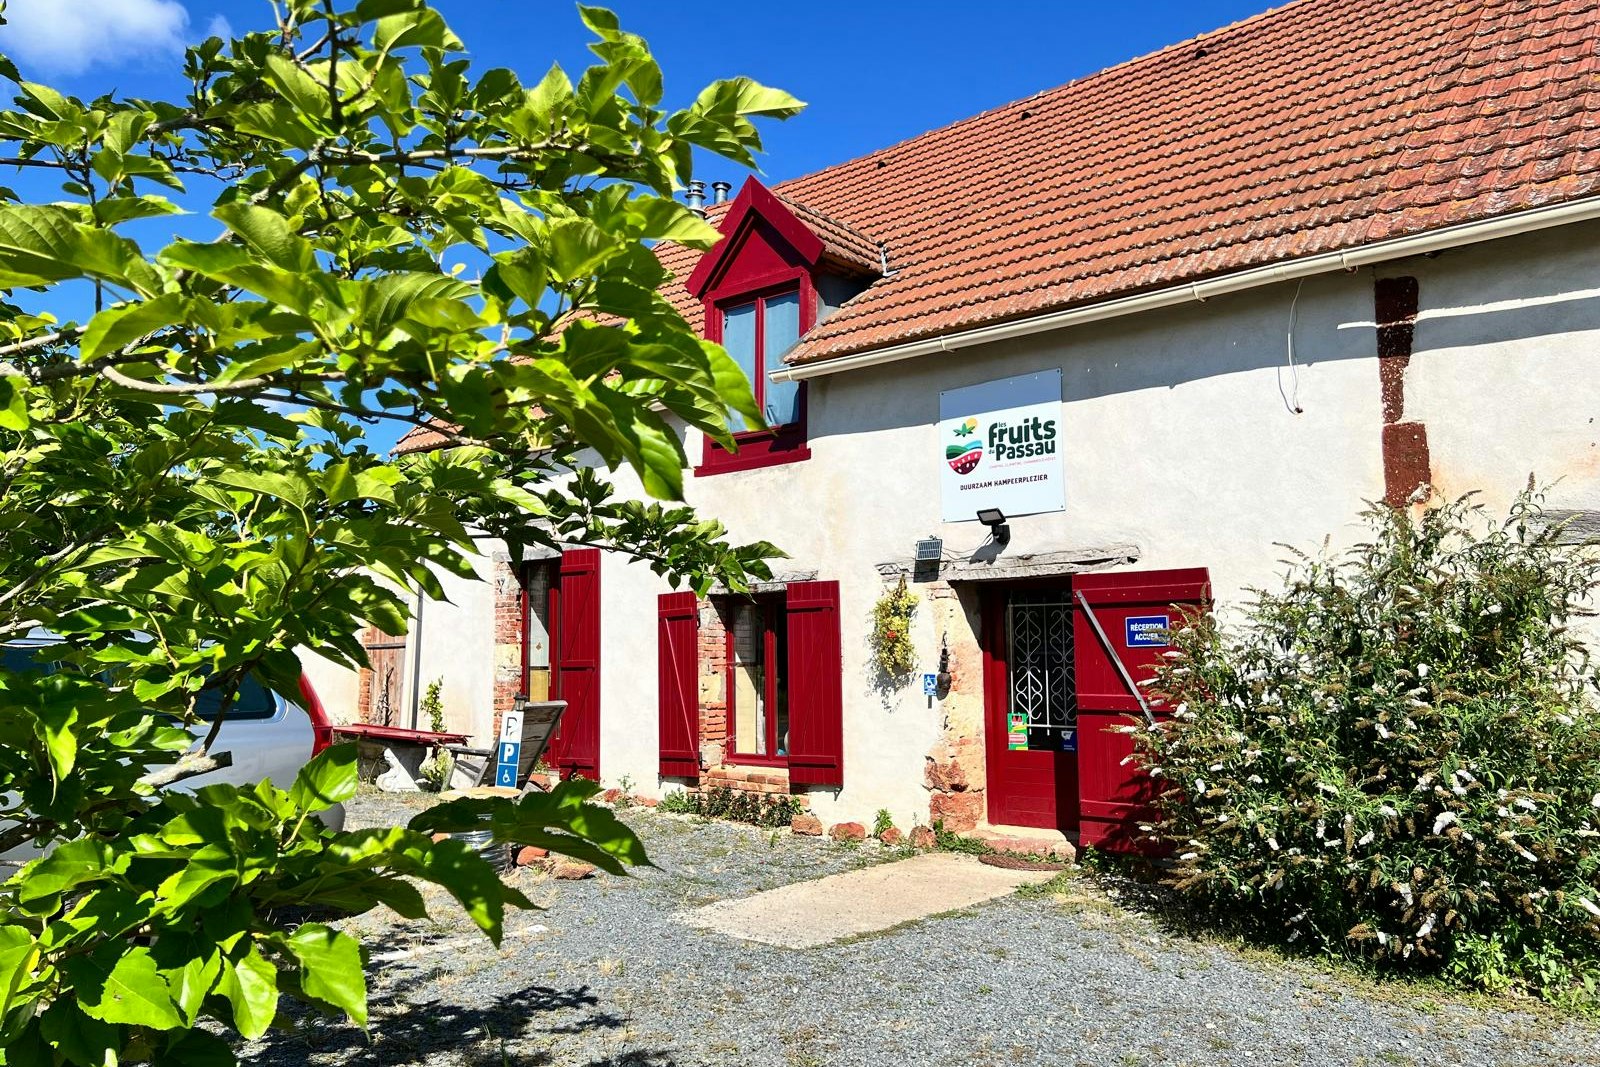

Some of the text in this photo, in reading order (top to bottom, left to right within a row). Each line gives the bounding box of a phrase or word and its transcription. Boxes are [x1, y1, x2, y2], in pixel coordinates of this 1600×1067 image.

[988, 416, 1056, 448] fruits
[996, 440, 1056, 461] Passau
[960, 474, 1049, 491] DUURZAAM KAMPEERPLEZIER
[1130, 622, 1164, 632] RÉCEPTION
[503, 743, 515, 763] P
